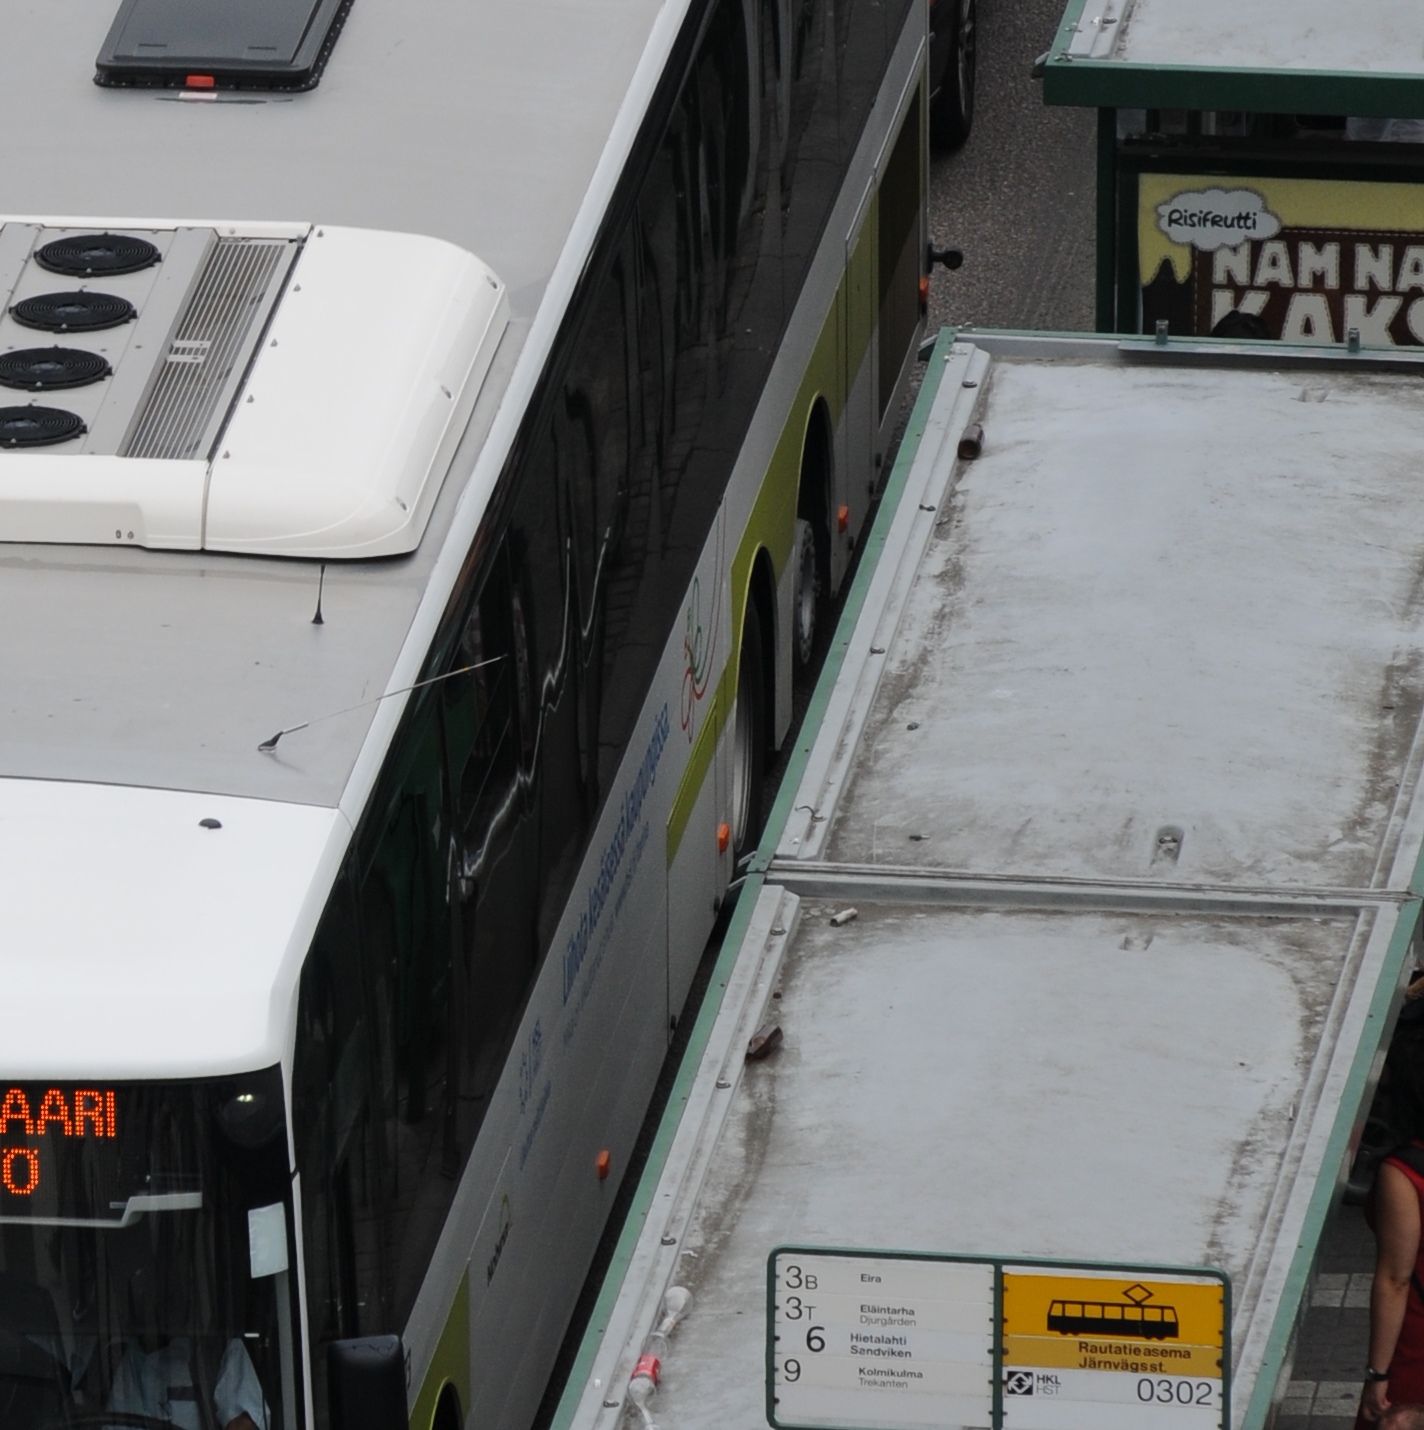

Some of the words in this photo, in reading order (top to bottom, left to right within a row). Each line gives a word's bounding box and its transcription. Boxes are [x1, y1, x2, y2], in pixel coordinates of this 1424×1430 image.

[1213, 239, 1341, 289] NAM
[860, 1273, 882, 1283] Eira
[860, 1304, 915, 1316] Eläintarha
[859, 1314, 917, 1327] Djurgården
[806, 1326, 825, 1352] 6
[850, 1333, 907, 1346] Hietalahti
[850, 1344, 912, 1358] Sandviken
[784, 1358, 801, 1382] 9
[858, 1367, 923, 1379] Kolmikulma
[858, 1377, 909, 1389] Trekanten
[1036, 1374, 1062, 1385] HKL
[1036, 1384, 1062, 1395] HST
[1137, 1378, 1213, 1406] 0302
